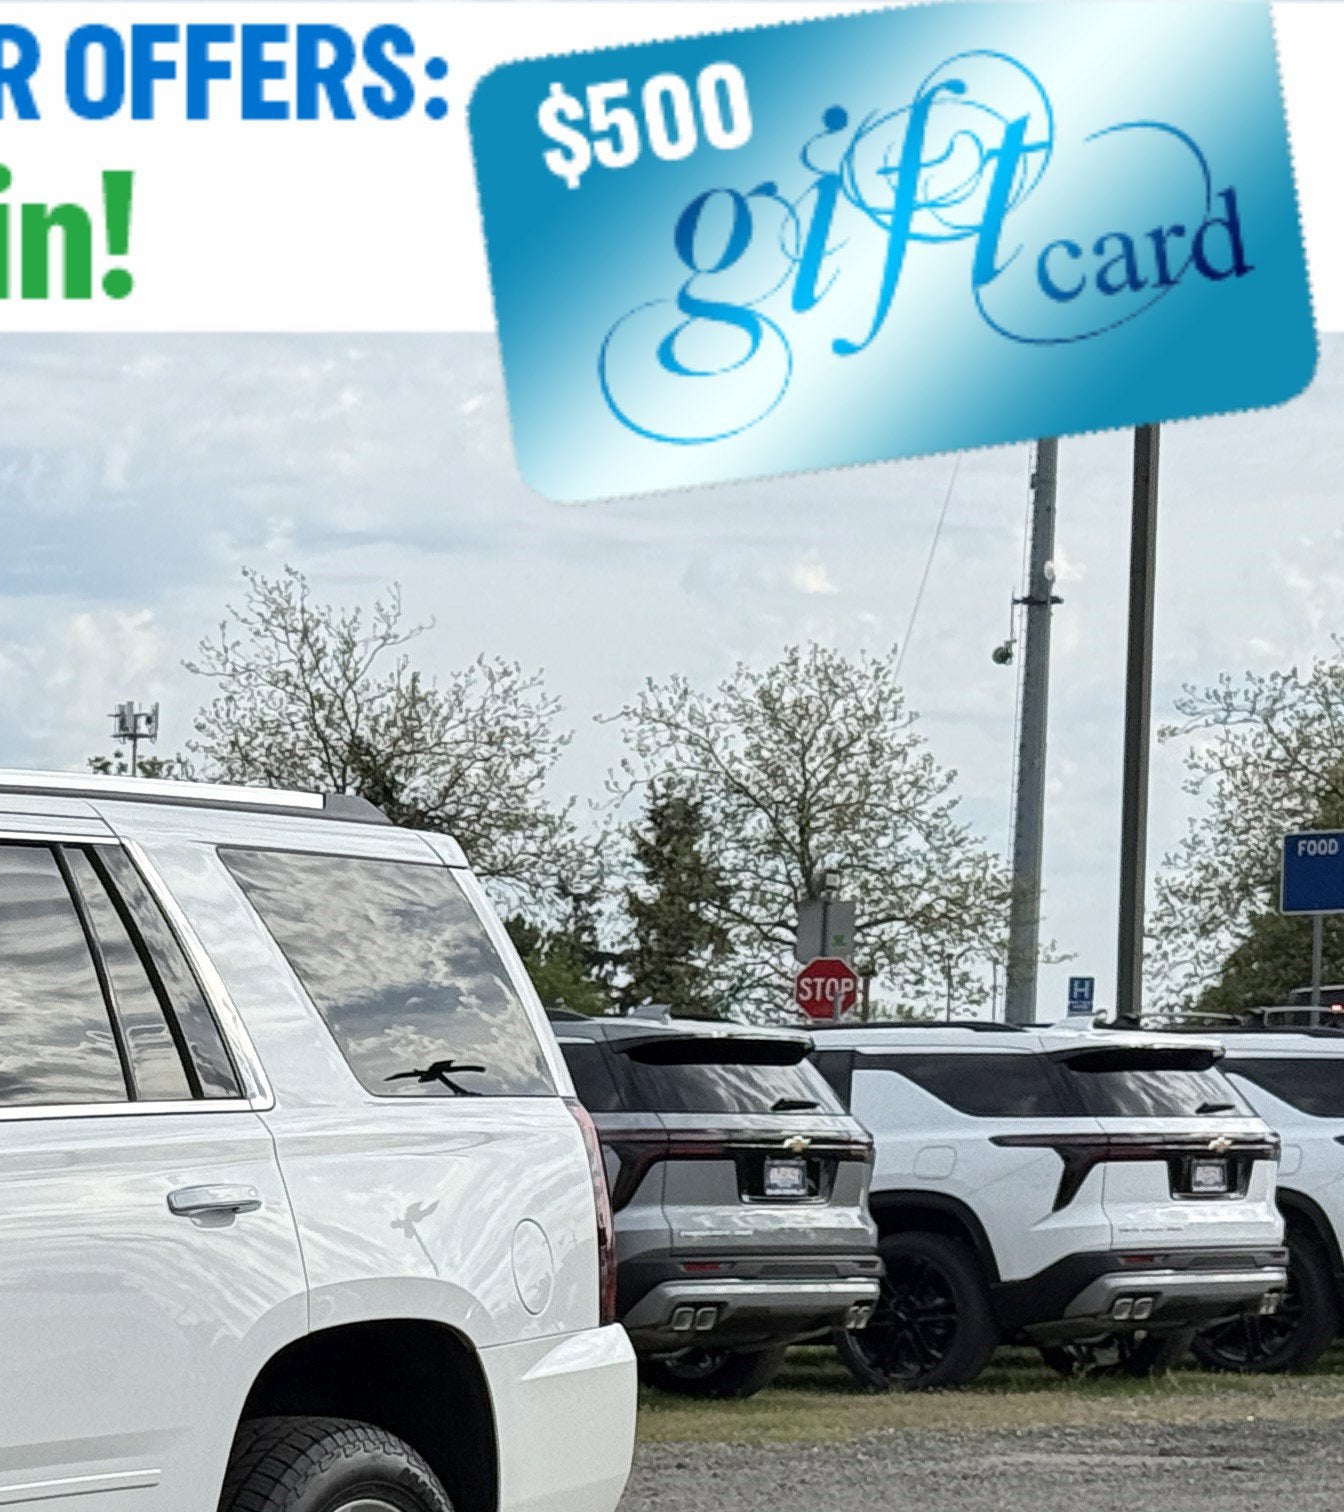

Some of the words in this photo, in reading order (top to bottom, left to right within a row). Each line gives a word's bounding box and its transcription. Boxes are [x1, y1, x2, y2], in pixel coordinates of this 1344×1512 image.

[1298, 839, 1339, 857] FOOD
[798, 977, 854, 1002] STOP
[1073, 980, 1090, 999] H
